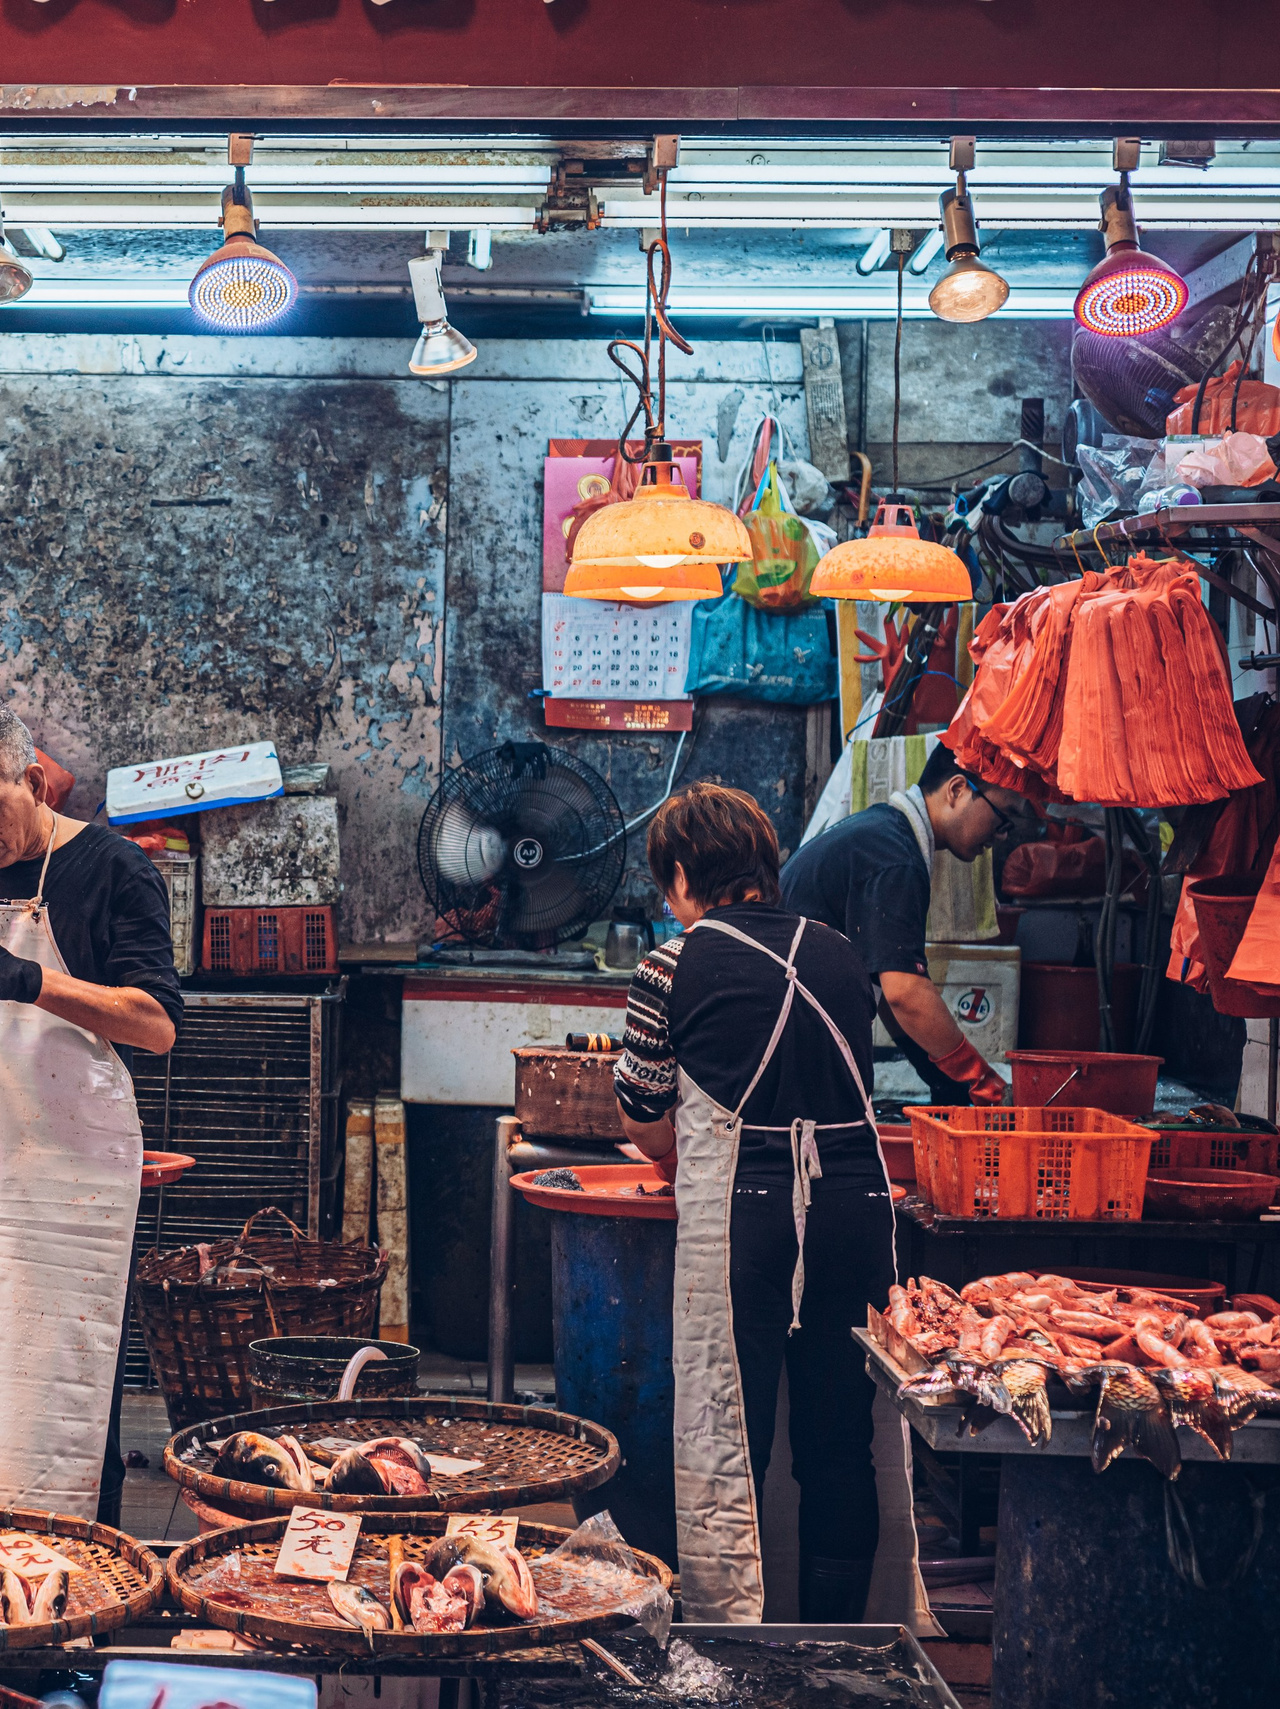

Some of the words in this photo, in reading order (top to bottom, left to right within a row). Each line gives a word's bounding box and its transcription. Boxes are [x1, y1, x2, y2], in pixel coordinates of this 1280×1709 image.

[290, 1511, 346, 1531] 50
[457, 1519, 513, 1542] 55
[294, 1535, 333, 1555] 元
[16, 1552, 53, 1568] 元
